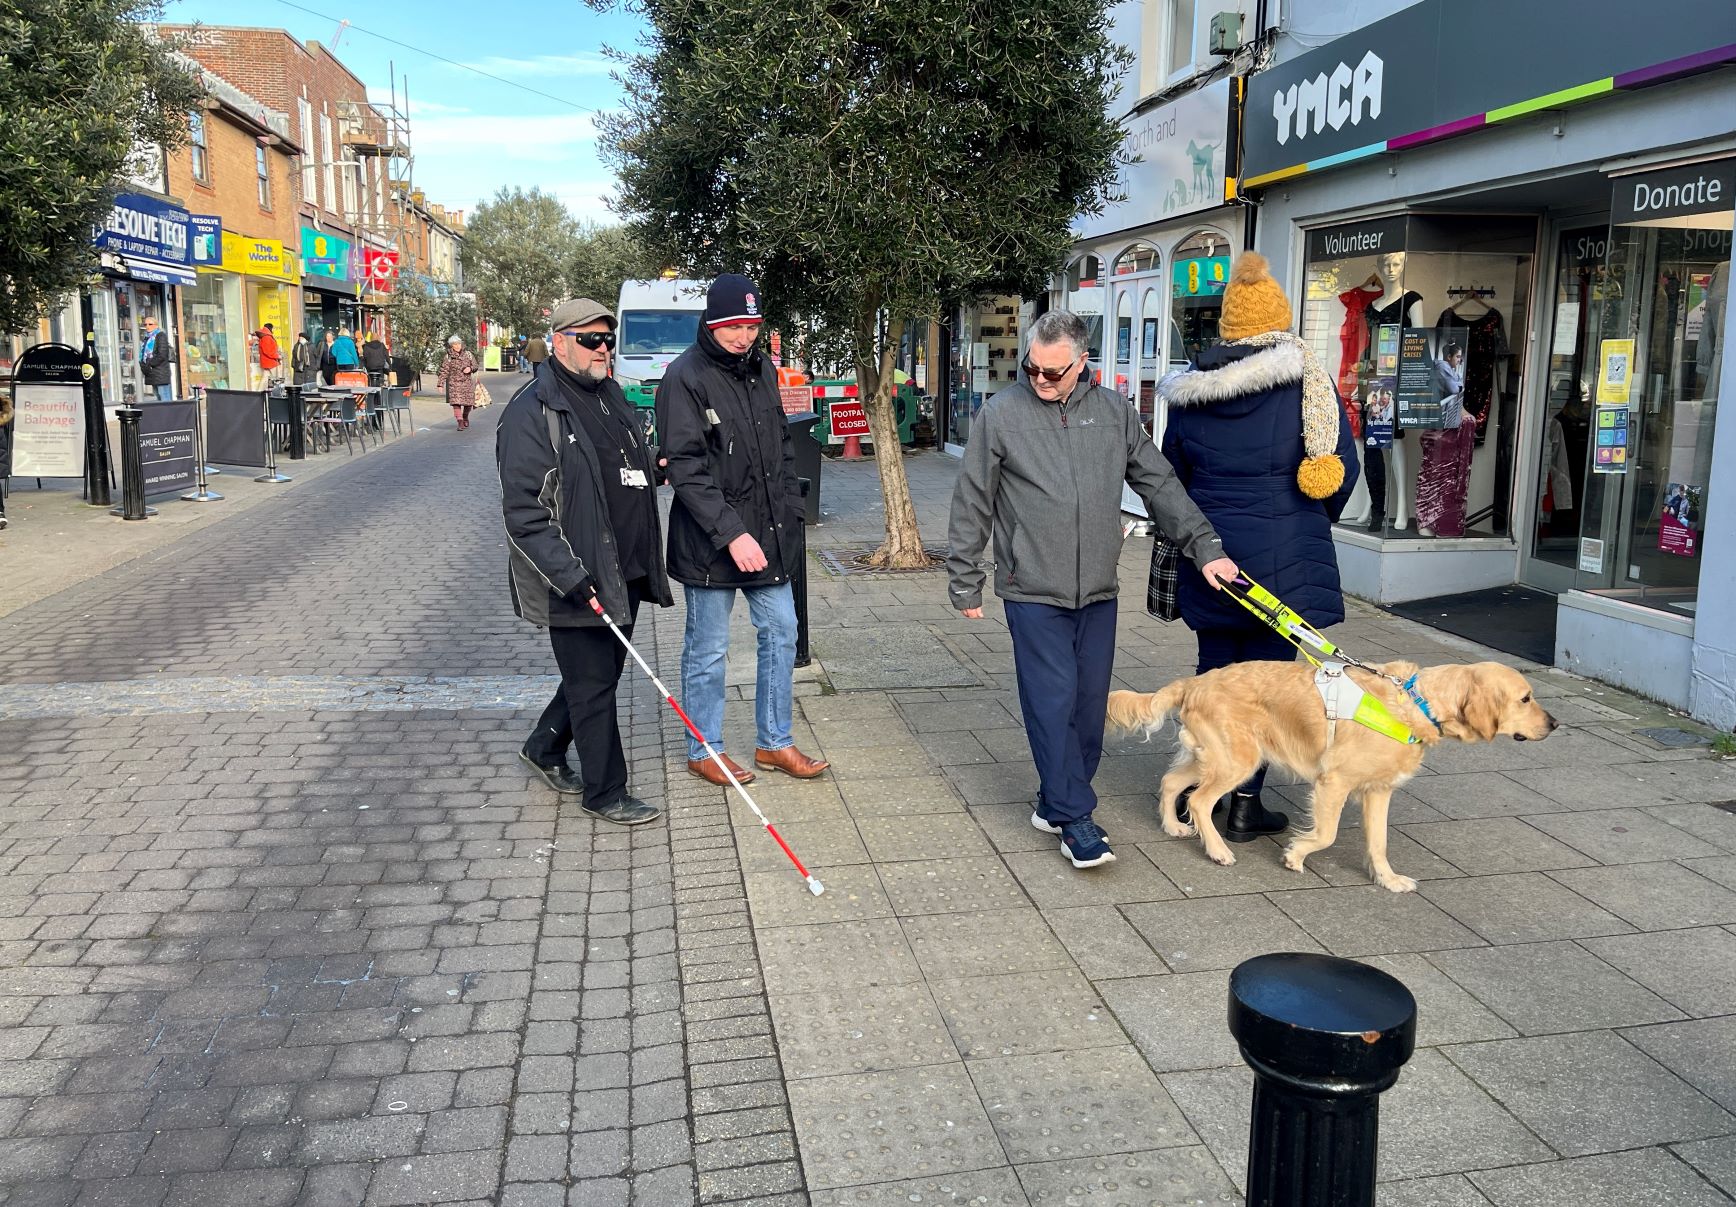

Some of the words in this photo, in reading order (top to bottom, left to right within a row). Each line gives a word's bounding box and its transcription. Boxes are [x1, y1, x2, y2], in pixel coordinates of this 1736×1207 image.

[1273, 50, 1383, 145] YMCA
[1125, 120, 1153, 152] North
[1157, 108, 1176, 142] and
[1633, 176, 1721, 212] Donate
[159, 219, 187, 249] TECH
[108, 237, 122, 249] PHONE
[128, 241, 144, 253] LAPTOP
[145, 245, 158, 256] REPAIR
[254, 244, 272, 252] The
[1325, 231, 1383, 254] Volunteer
[1576, 236, 1616, 262] Shop
[249, 253, 279, 262] Works
[24, 400, 77, 412] Beautiful
[833, 408, 865, 418] FOOTPAT
[24, 413, 76, 428] Balayage
[838, 420, 867, 429] CLOSED
[140, 438, 161, 448] SAMUEL
[163, 434, 190, 445] CHAPMAN
[145, 476, 159, 484] AWARD
[159, 473, 176, 482] WINNING
